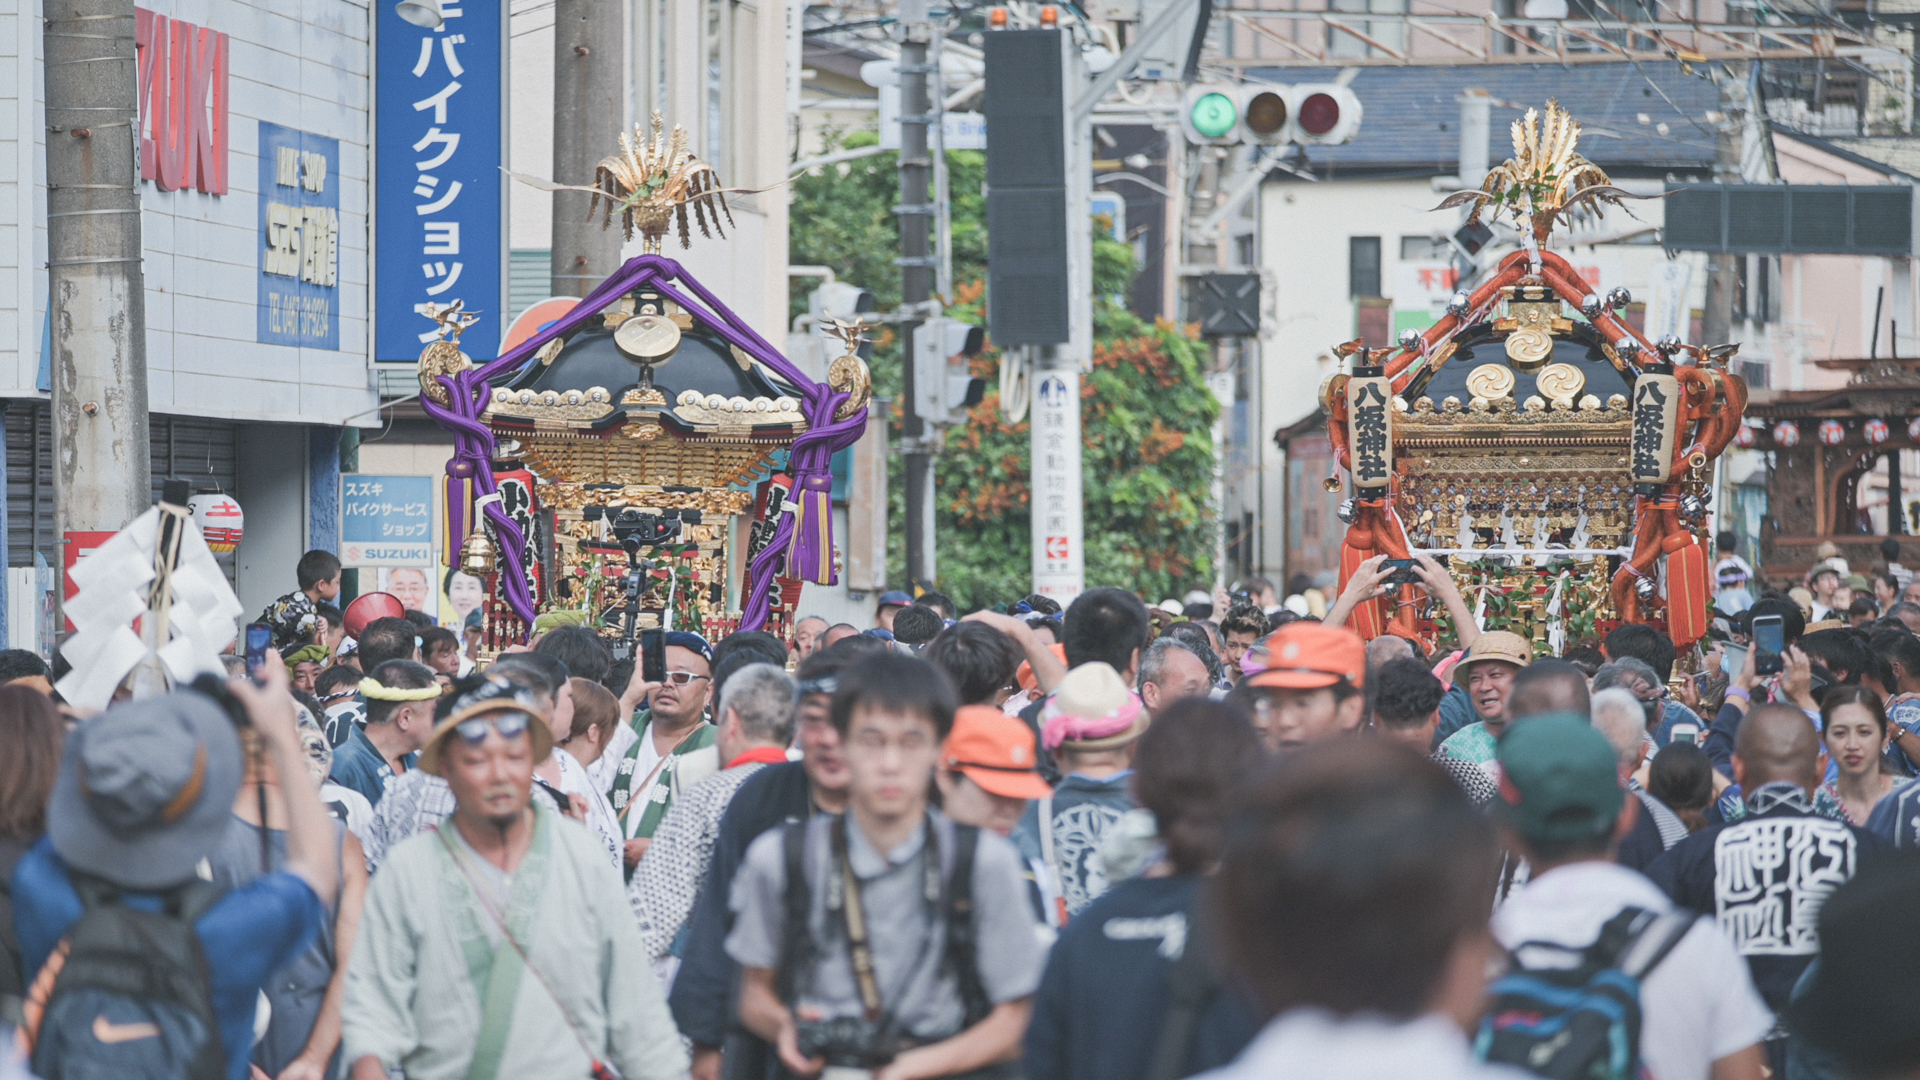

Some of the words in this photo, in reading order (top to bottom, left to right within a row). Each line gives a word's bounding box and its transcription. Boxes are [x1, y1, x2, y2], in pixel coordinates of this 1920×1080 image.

[269, 292, 281, 333] TEL
[1354, 382, 1387, 481] 八坂神社
[1632, 381, 1667, 479] 八坂神社
[346, 482, 383, 497] スズキ
[346, 502, 428, 517] バイクサービス
[383, 522, 428, 537] ショップ
[365, 549, 428, 559] SUZUKI
